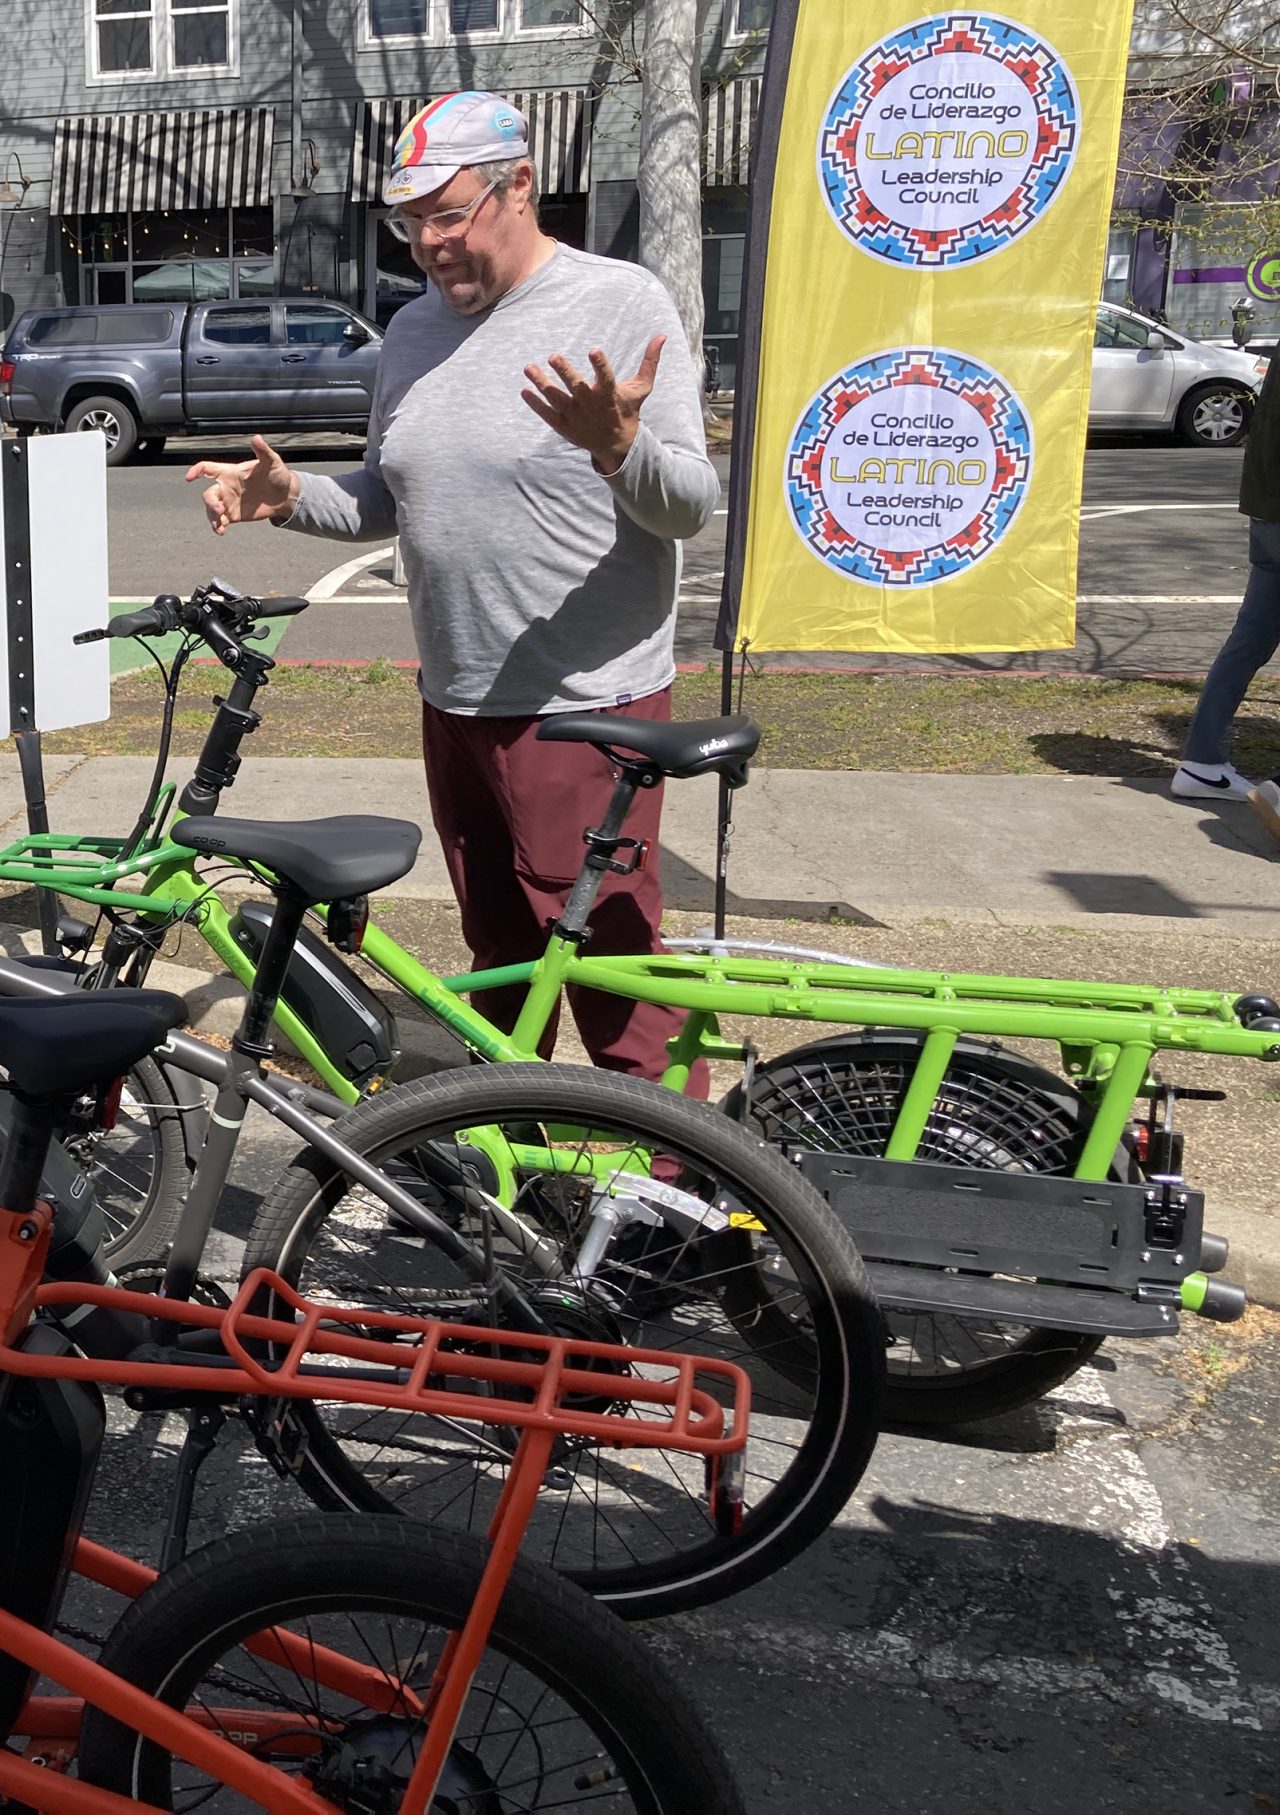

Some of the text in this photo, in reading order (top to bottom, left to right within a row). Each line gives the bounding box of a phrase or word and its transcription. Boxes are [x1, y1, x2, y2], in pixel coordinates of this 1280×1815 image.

[910, 82, 995, 99] Concilio
[880, 103, 1021, 124] de Liderazgo
[865, 130, 1029, 160] LATINO
[881, 168, 1003, 187] Leadership
[898, 188, 979, 204] Council
[870, 413, 954, 430] Concilio
[843, 431, 979, 453] de Liderazgo
[829, 457, 987, 486] LATINO
[847, 492, 964, 512] Leadership
[864, 511, 942, 527] Council
[205, 930, 247, 972] FASTRACK
